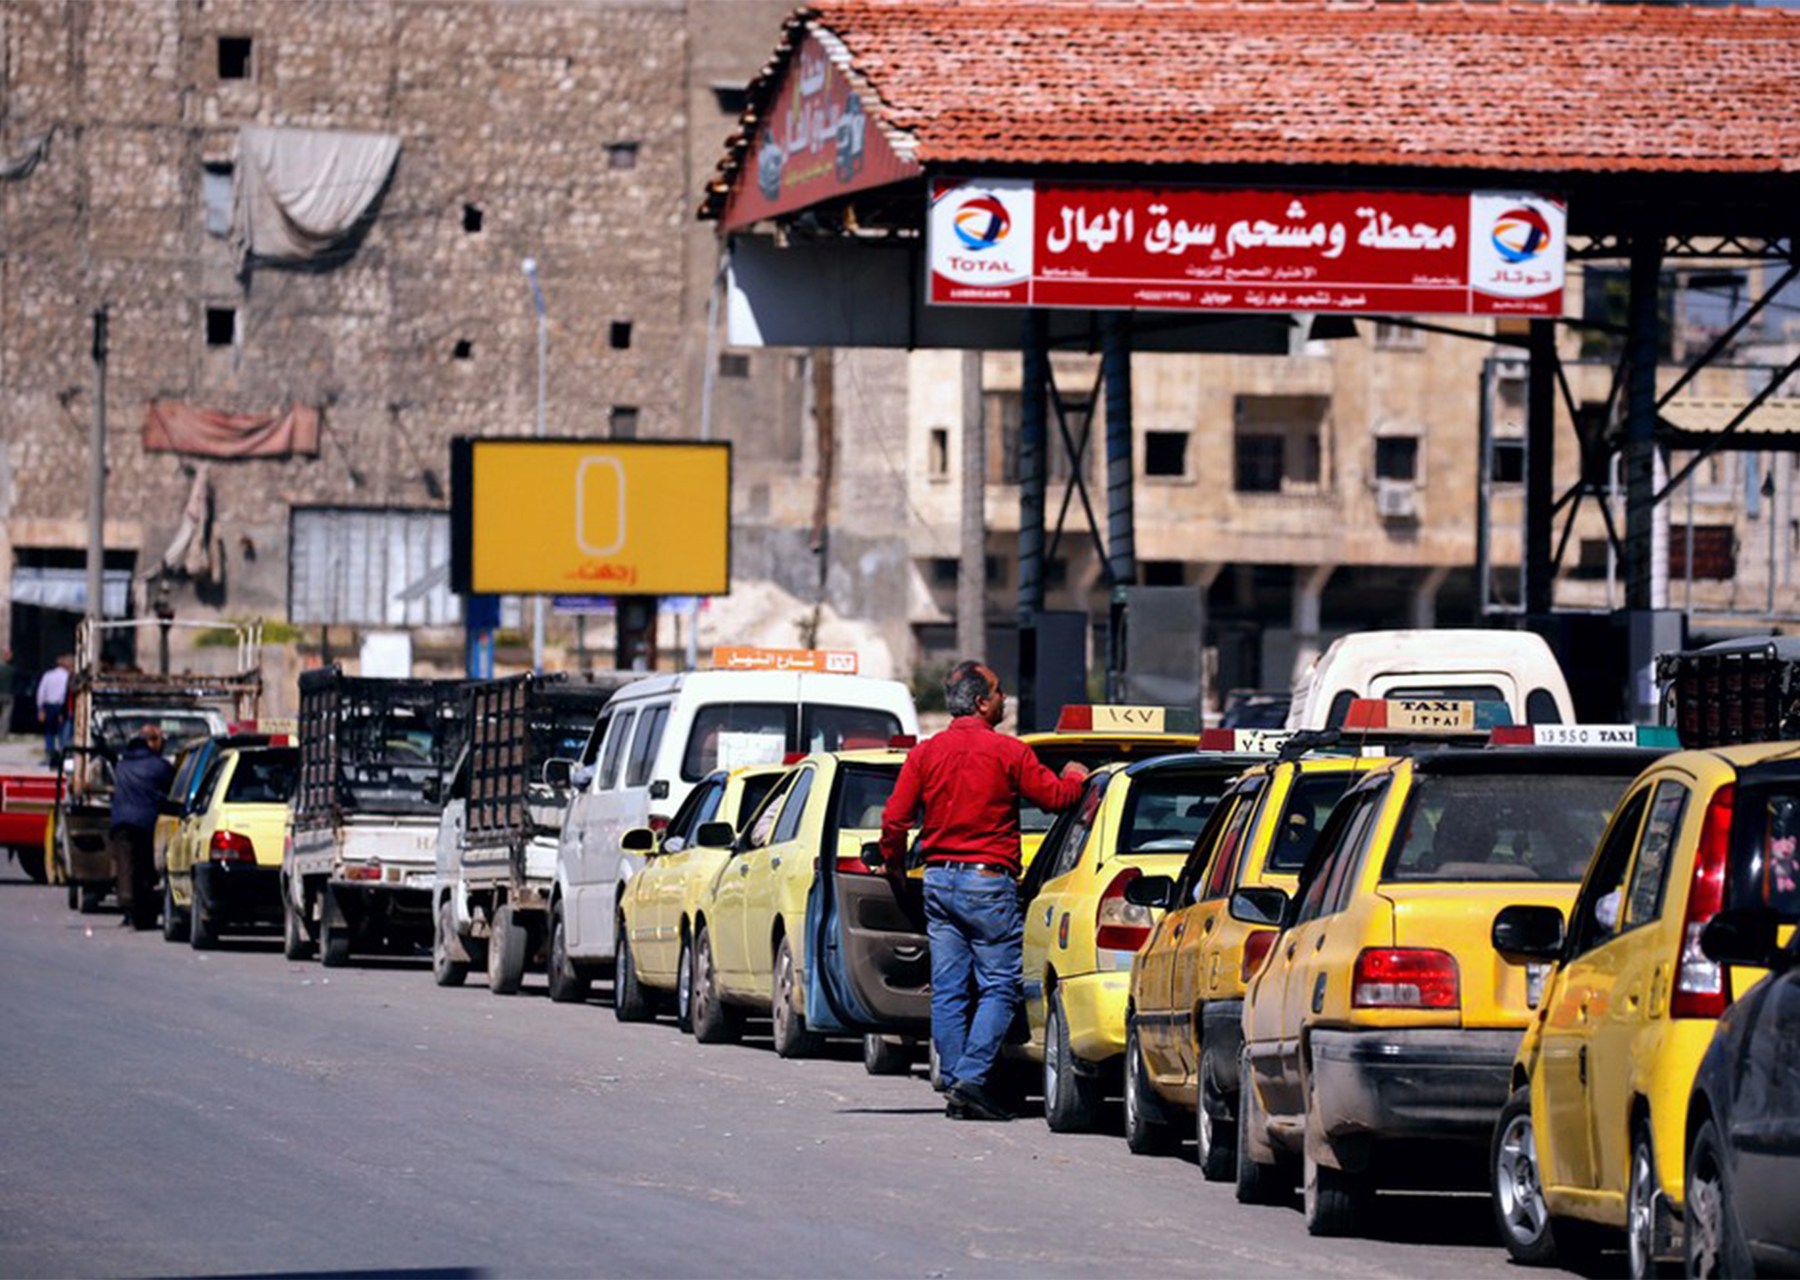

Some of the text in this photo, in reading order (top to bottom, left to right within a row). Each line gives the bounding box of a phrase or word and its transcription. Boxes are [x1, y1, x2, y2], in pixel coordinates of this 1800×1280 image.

[1046, 199, 1456, 258] محطة ومشحم سوق الهال
[947, 256, 1016, 272] TOTAL
[1489, 270, 1551, 285] توتال
[1400, 701, 1460, 711] TAXI
[1599, 731, 1634, 743] TAXI
